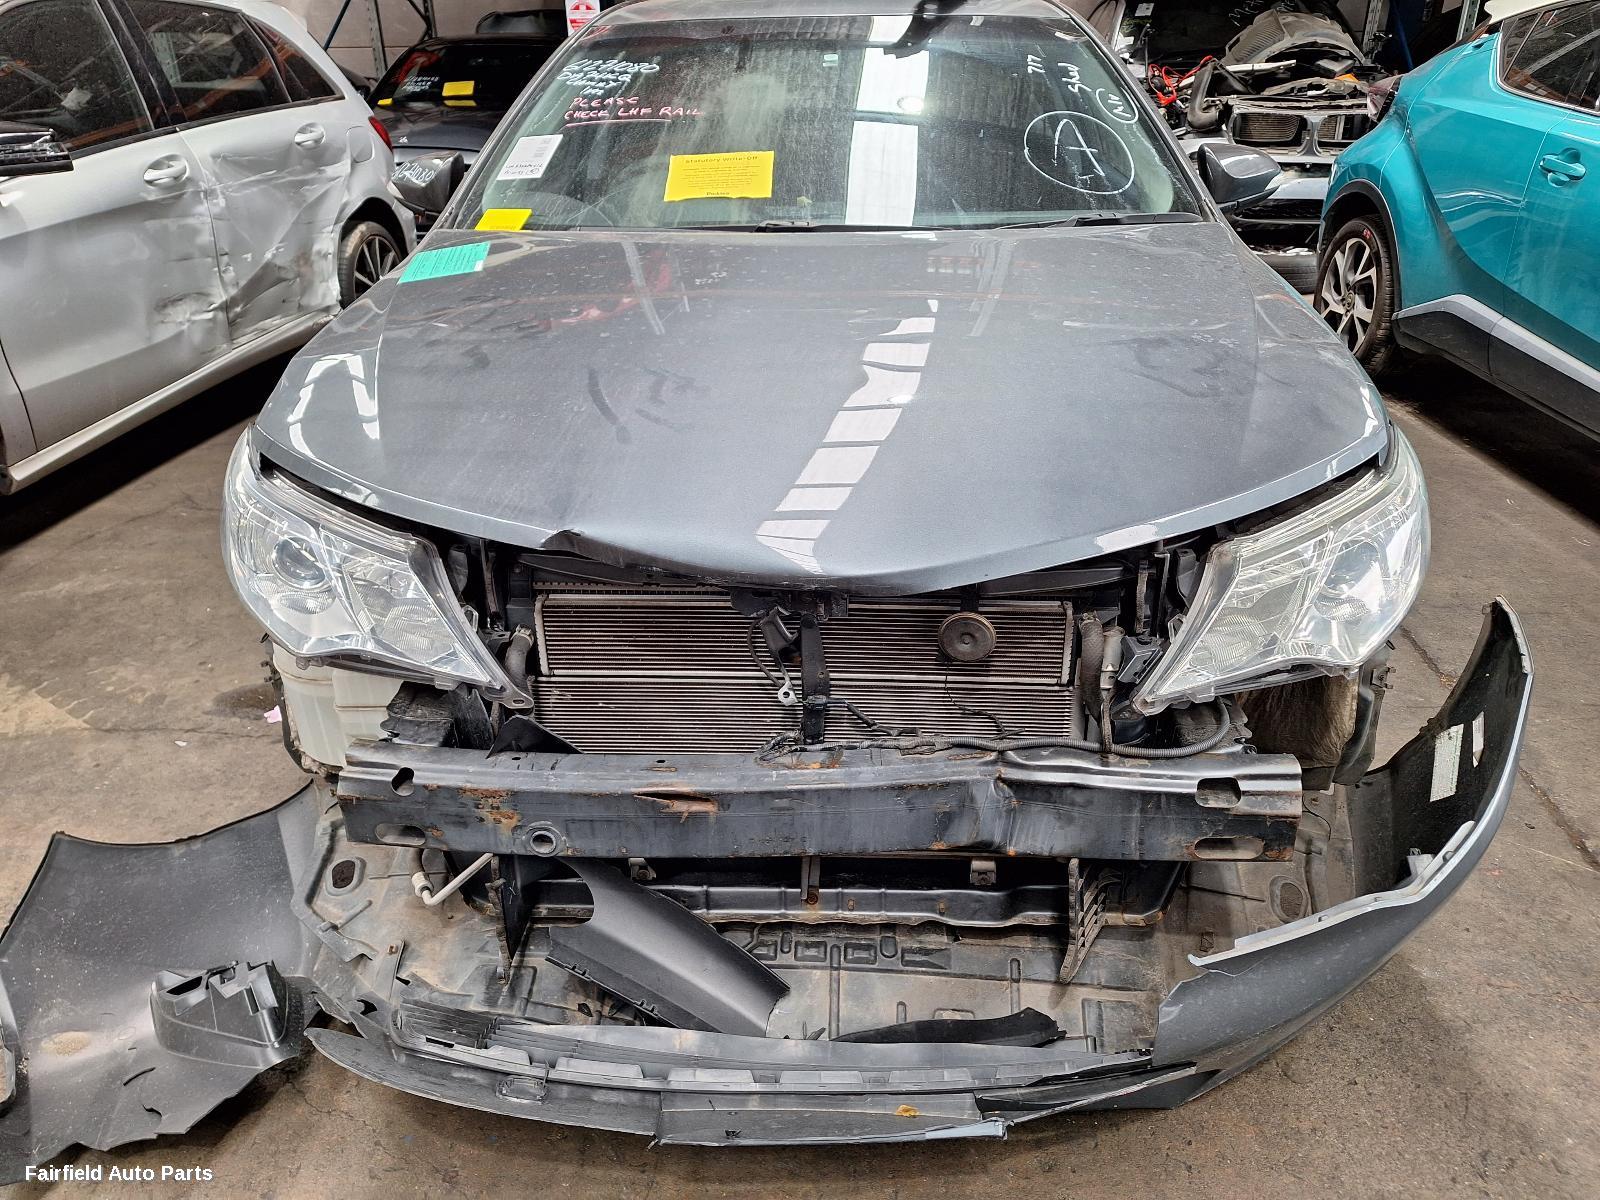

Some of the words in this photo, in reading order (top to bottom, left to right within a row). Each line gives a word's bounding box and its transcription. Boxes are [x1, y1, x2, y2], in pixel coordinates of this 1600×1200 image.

[569, 96, 640, 109] PLEASE
[564, 109, 611, 120] CHECK
[617, 107, 653, 117] LHF
[658, 106, 704, 118] RAIL
